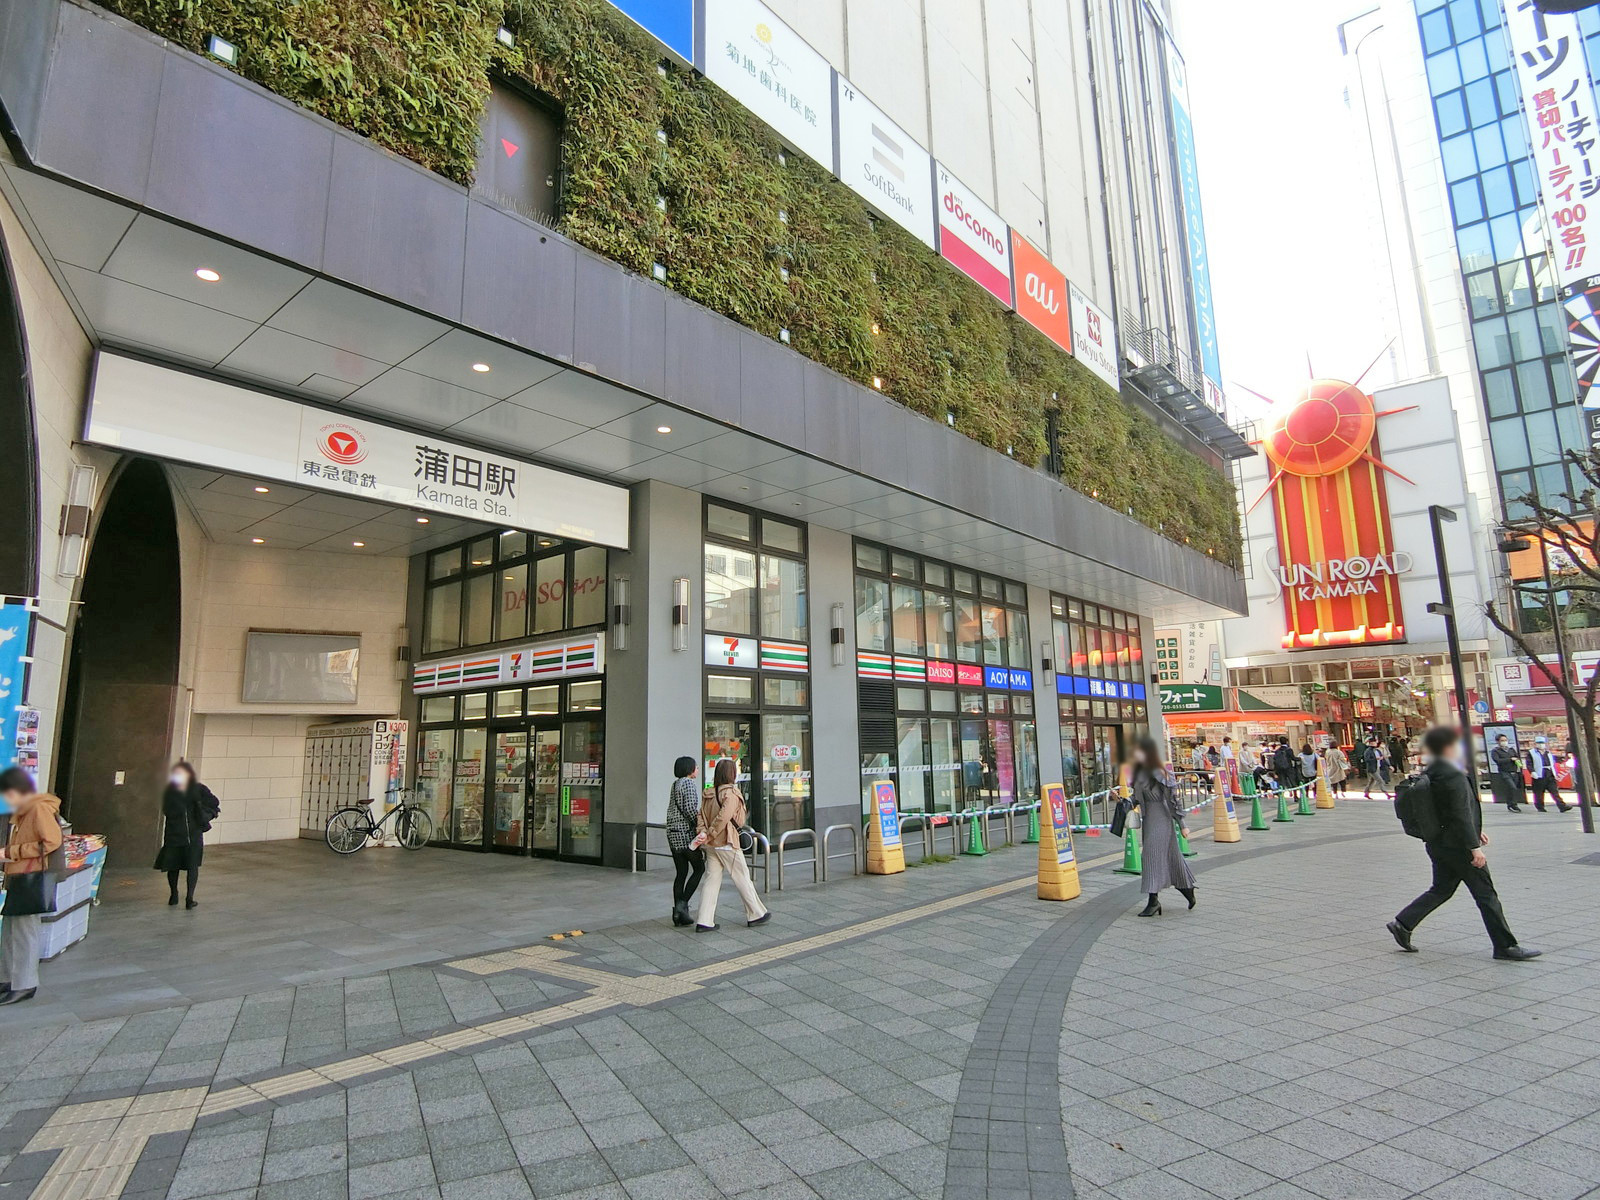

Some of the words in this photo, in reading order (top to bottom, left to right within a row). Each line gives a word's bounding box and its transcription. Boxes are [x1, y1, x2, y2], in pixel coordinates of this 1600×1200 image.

[725, 40, 817, 128] 菊地歯科医院
[843, 84, 855, 102] 7F
[863, 163, 914, 215] SoftBank
[940, 170, 949, 184] 7F
[943, 191, 1004, 256] docomo
[1024, 272, 1059, 315] au
[1564, 286, 1573, 297] 5
[1075, 331, 1098, 362] Tokyu
[1099, 351, 1118, 378] Store
[303, 460, 377, 490] 東急電鉄
[414, 444, 516, 500] 蒲田駅
[416, 483, 478, 511] Kamata
[483, 497, 511, 517] Sta.
[1262, 546, 1322, 605] SUN
[1328, 551, 1413, 582] ROAD
[1298, 578, 1378, 602] KAMATA
[504, 579, 565, 612] DASO
[928, 667, 953, 678] DAISO
[990, 672, 1027, 686] AOYAMA
[1160, 688, 1206, 704] フォート
[375, 734, 395, 742] コイ
[775, 747, 788, 757] たばこ
